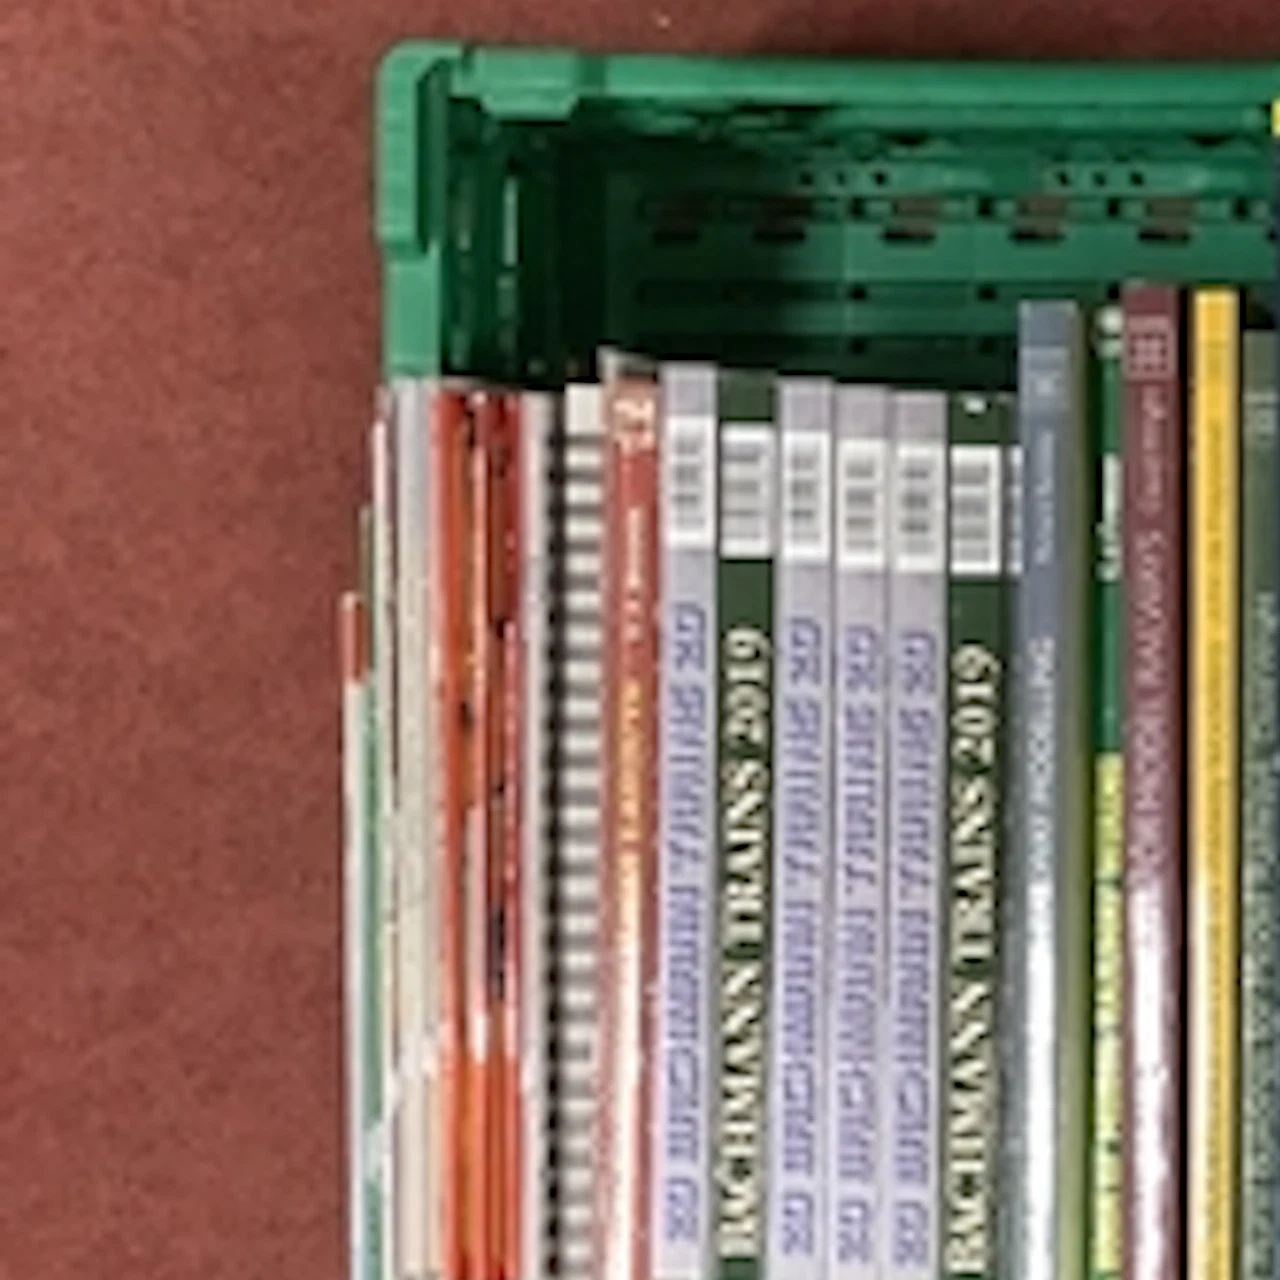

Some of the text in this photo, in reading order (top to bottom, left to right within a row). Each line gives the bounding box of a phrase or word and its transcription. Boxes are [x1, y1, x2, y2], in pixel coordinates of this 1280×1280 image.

[1129, 690, 1165, 809] MODEL
[1132, 531, 1167, 684] RAILWAYS
[718, 627, 770, 1257] BACHMANN TRAINS 2019
[946, 643, 998, 1271] BACHMANN TRAINS 2019
